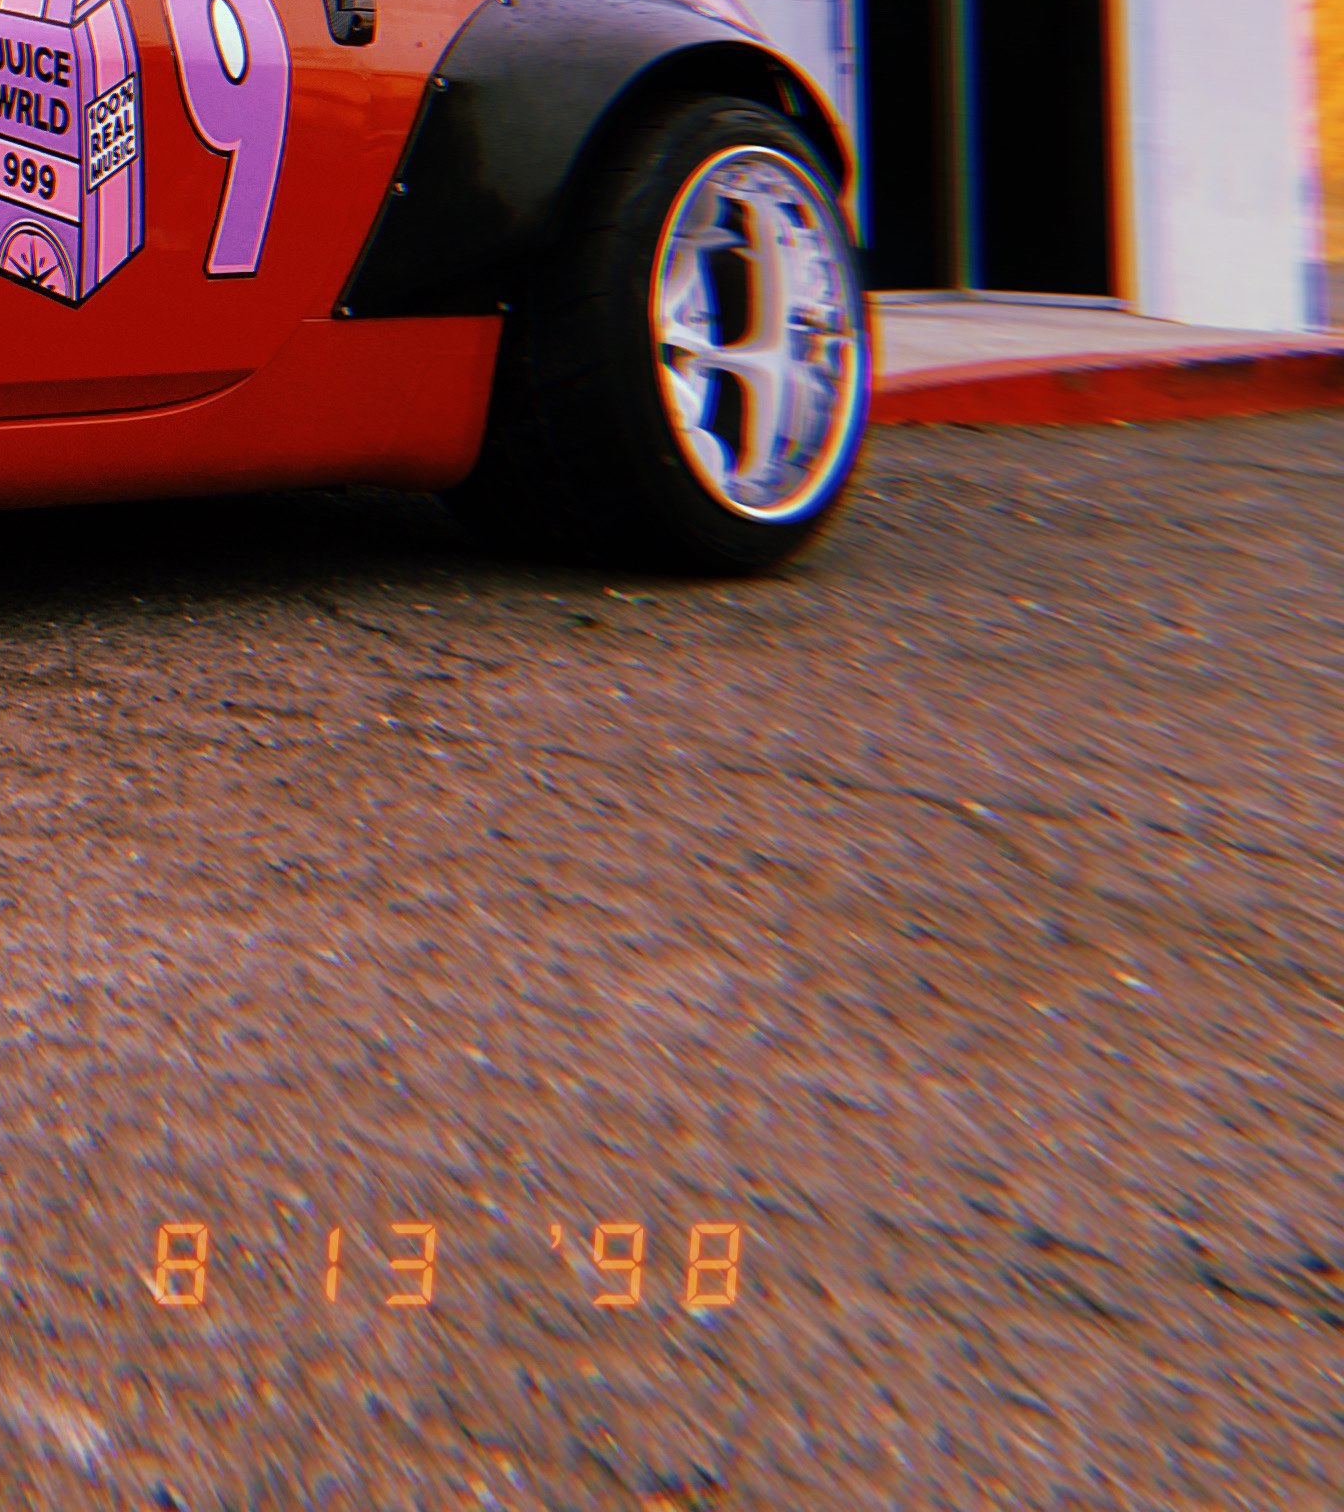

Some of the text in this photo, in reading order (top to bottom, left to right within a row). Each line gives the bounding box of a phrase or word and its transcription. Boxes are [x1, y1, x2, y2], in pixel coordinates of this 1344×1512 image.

[88, 82, 134, 130] 100%
[90, 109, 134, 158] REAL
[3, 152, 58, 201] 999
[90, 135, 135, 182] MUSIC
